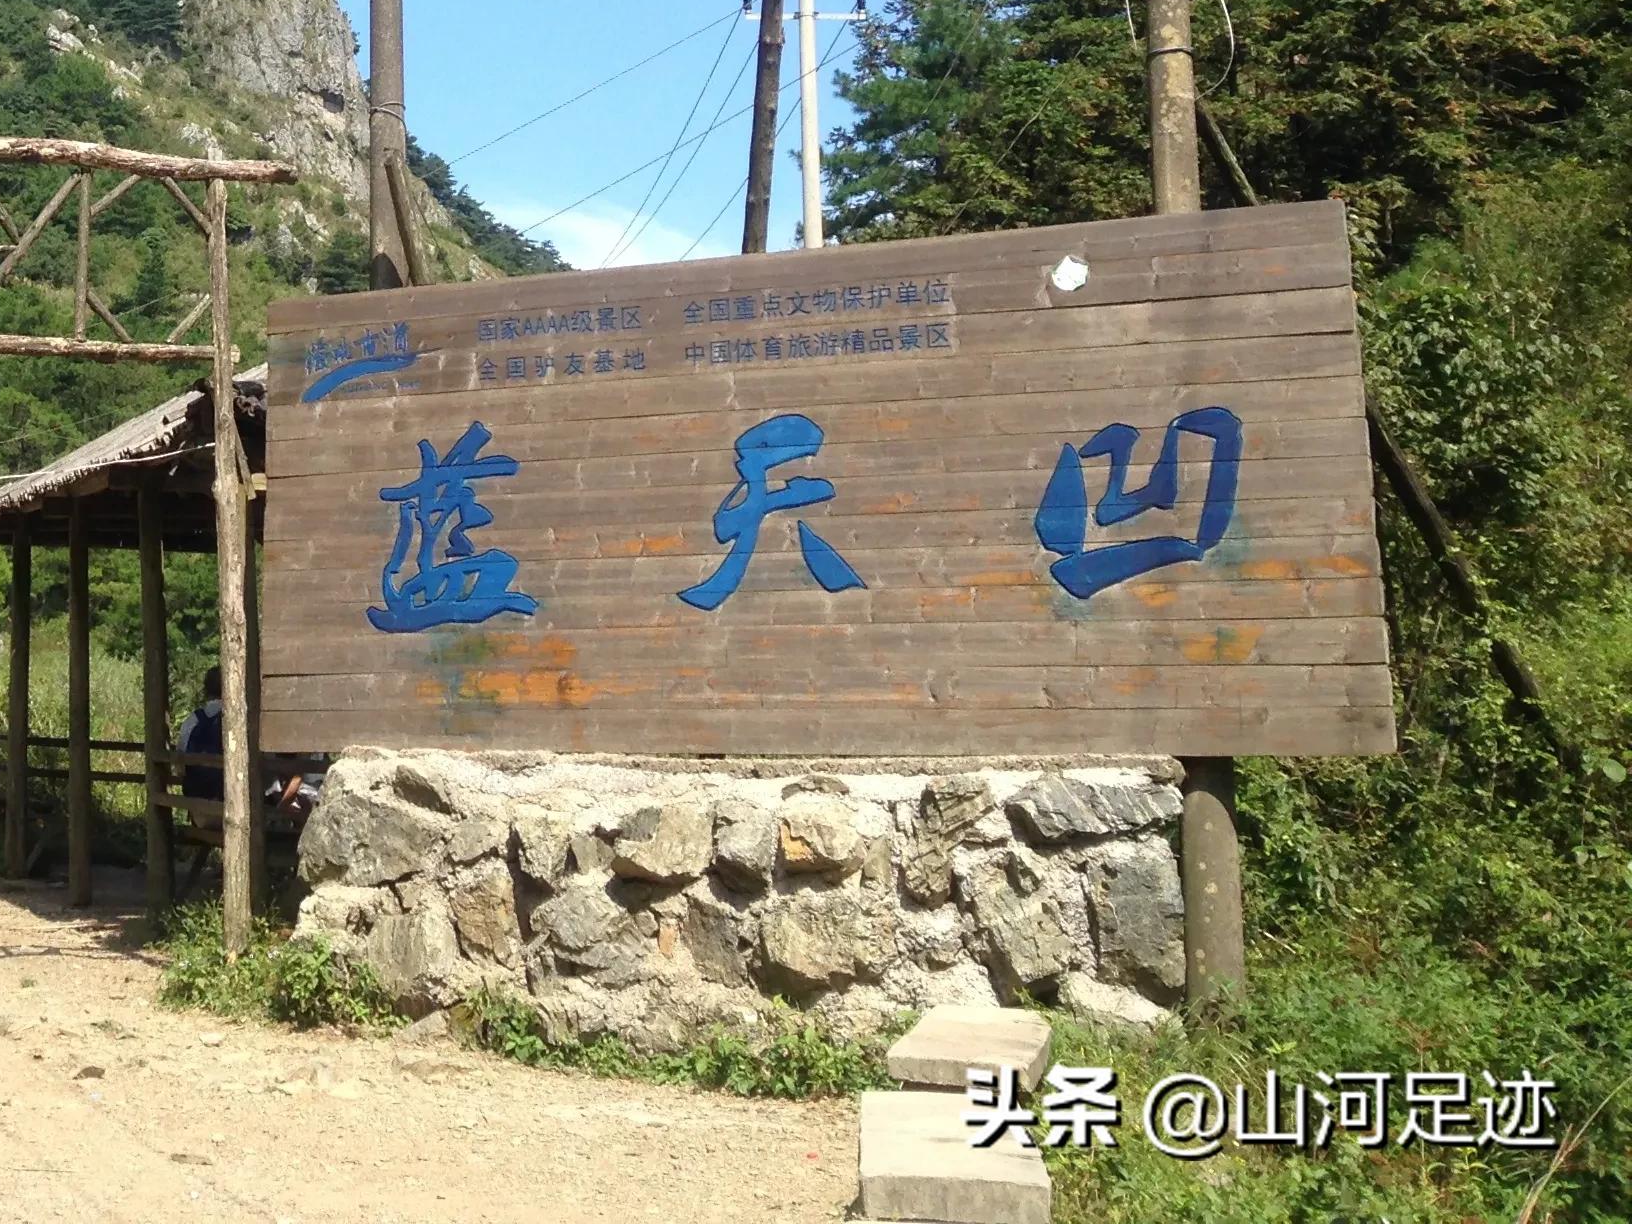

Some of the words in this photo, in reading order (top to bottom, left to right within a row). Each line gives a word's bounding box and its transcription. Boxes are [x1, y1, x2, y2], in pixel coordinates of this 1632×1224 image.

[683, 279, 950, 324] 全国重点文物保护单位
[477, 305, 643, 342] 国家AAAA级景区
[684, 323, 951, 366] 中国体育旅游精品景区
[478, 347, 645, 382] 全国驴友基地
[367, 406, 1243, 633] 蓝天凹
